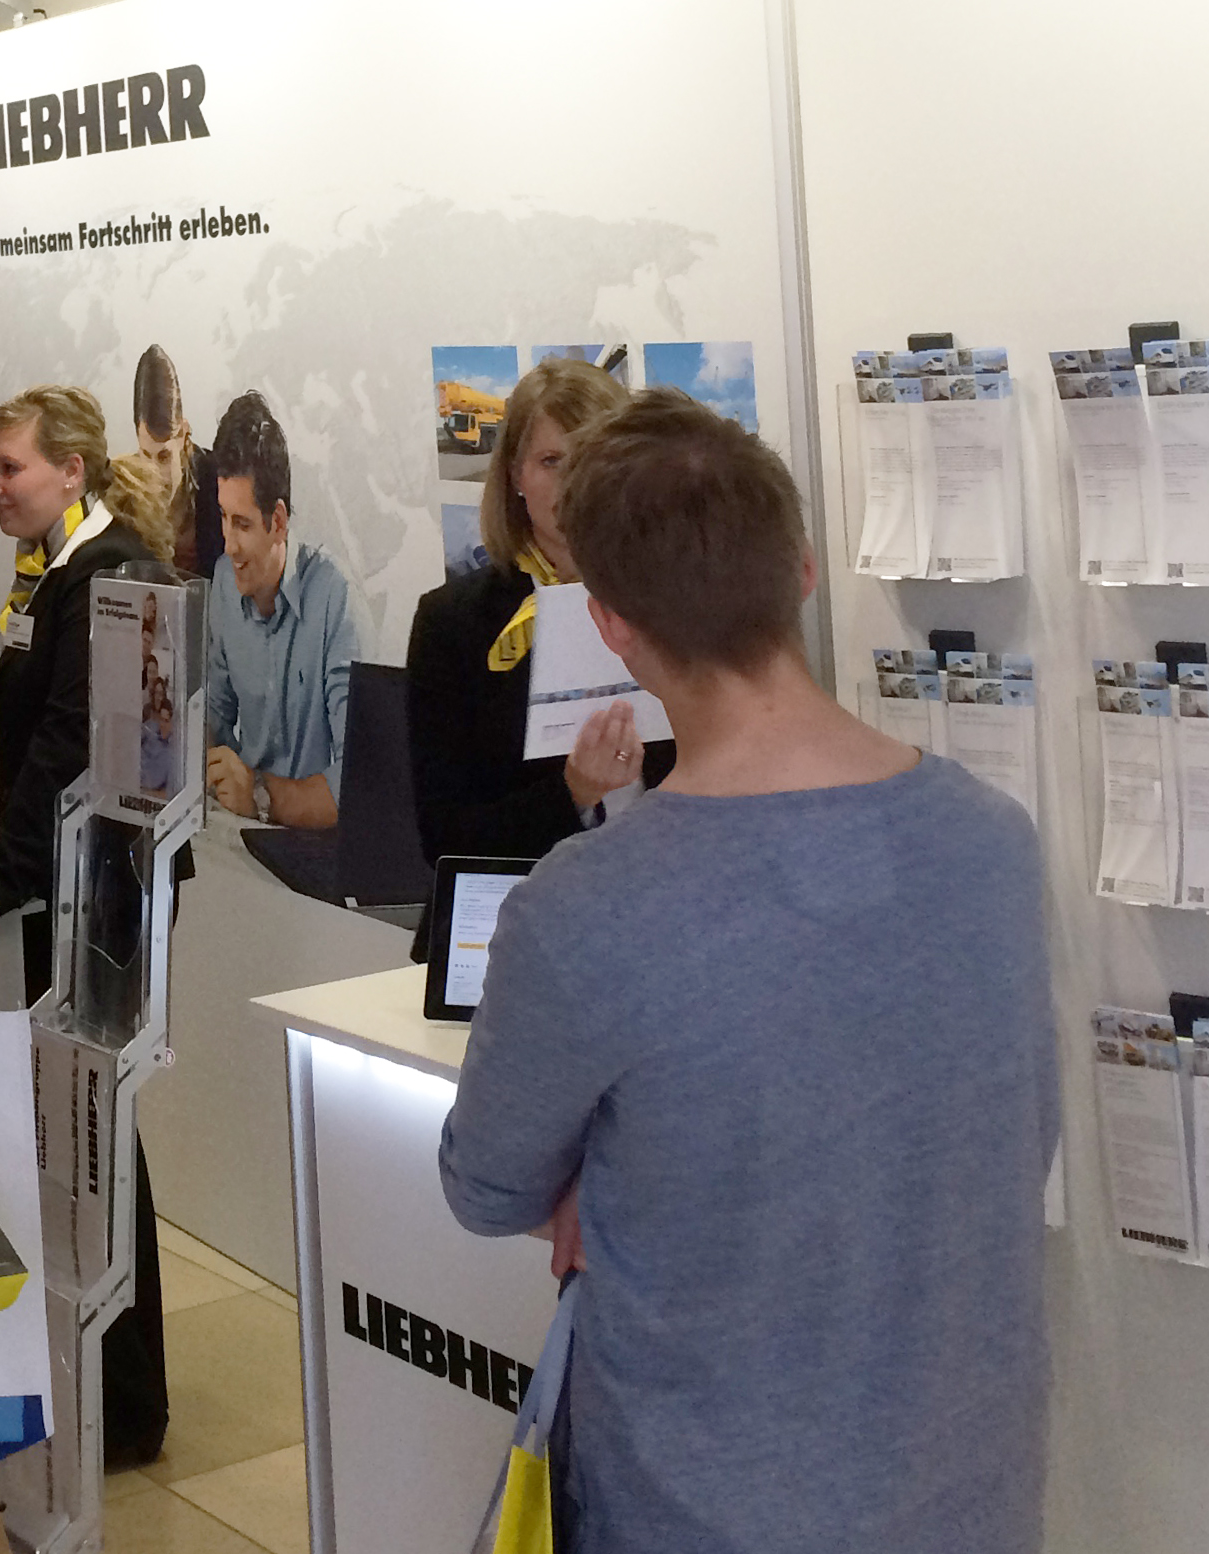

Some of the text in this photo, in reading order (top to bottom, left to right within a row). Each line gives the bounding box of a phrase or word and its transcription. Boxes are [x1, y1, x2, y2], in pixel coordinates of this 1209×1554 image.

[79, 212, 172, 250] Fortschritt
[179, 205, 270, 241] erleben.
[342, 1281, 535, 1415] LIEBHE
